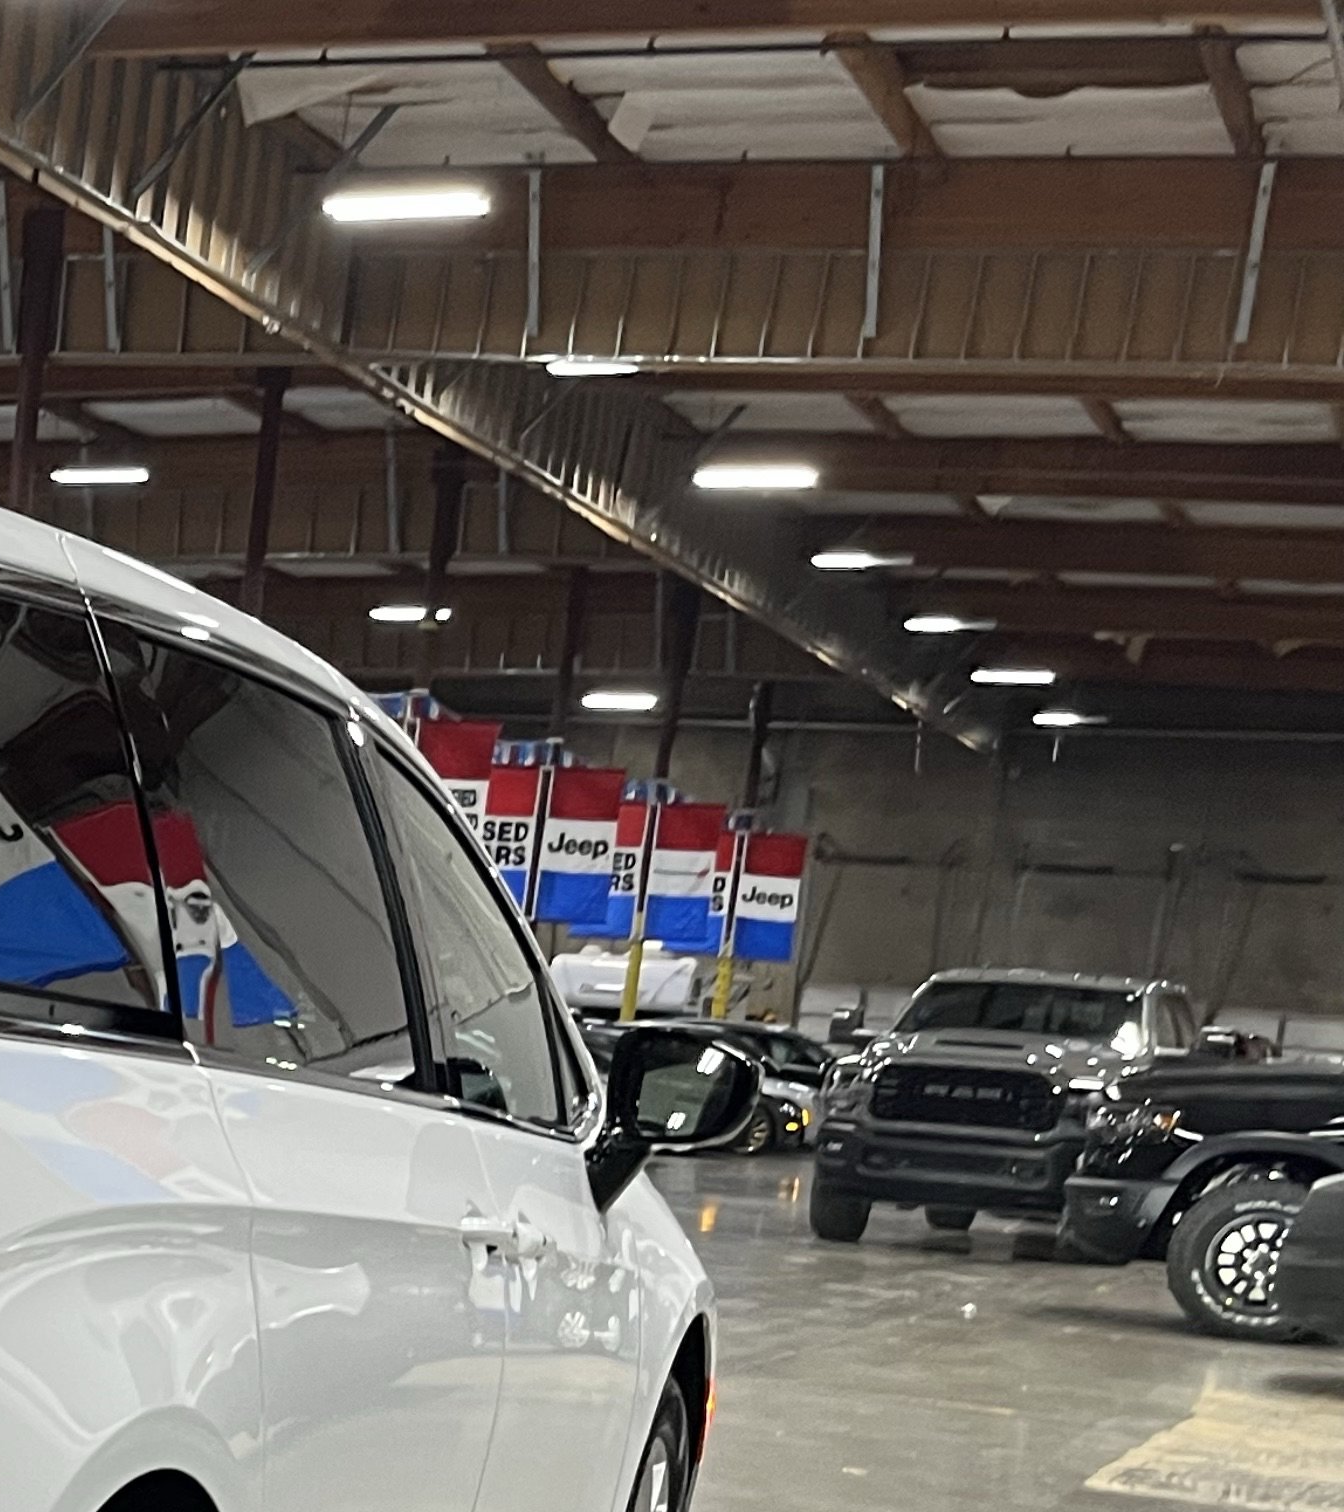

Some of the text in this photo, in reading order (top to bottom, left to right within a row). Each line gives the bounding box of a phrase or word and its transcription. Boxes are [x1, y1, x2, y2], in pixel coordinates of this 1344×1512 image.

[482, 821, 529, 843] SED
[484, 844, 526, 866] RS
[547, 832, 609, 860] Jeep
[741, 886, 794, 910] Jeep
